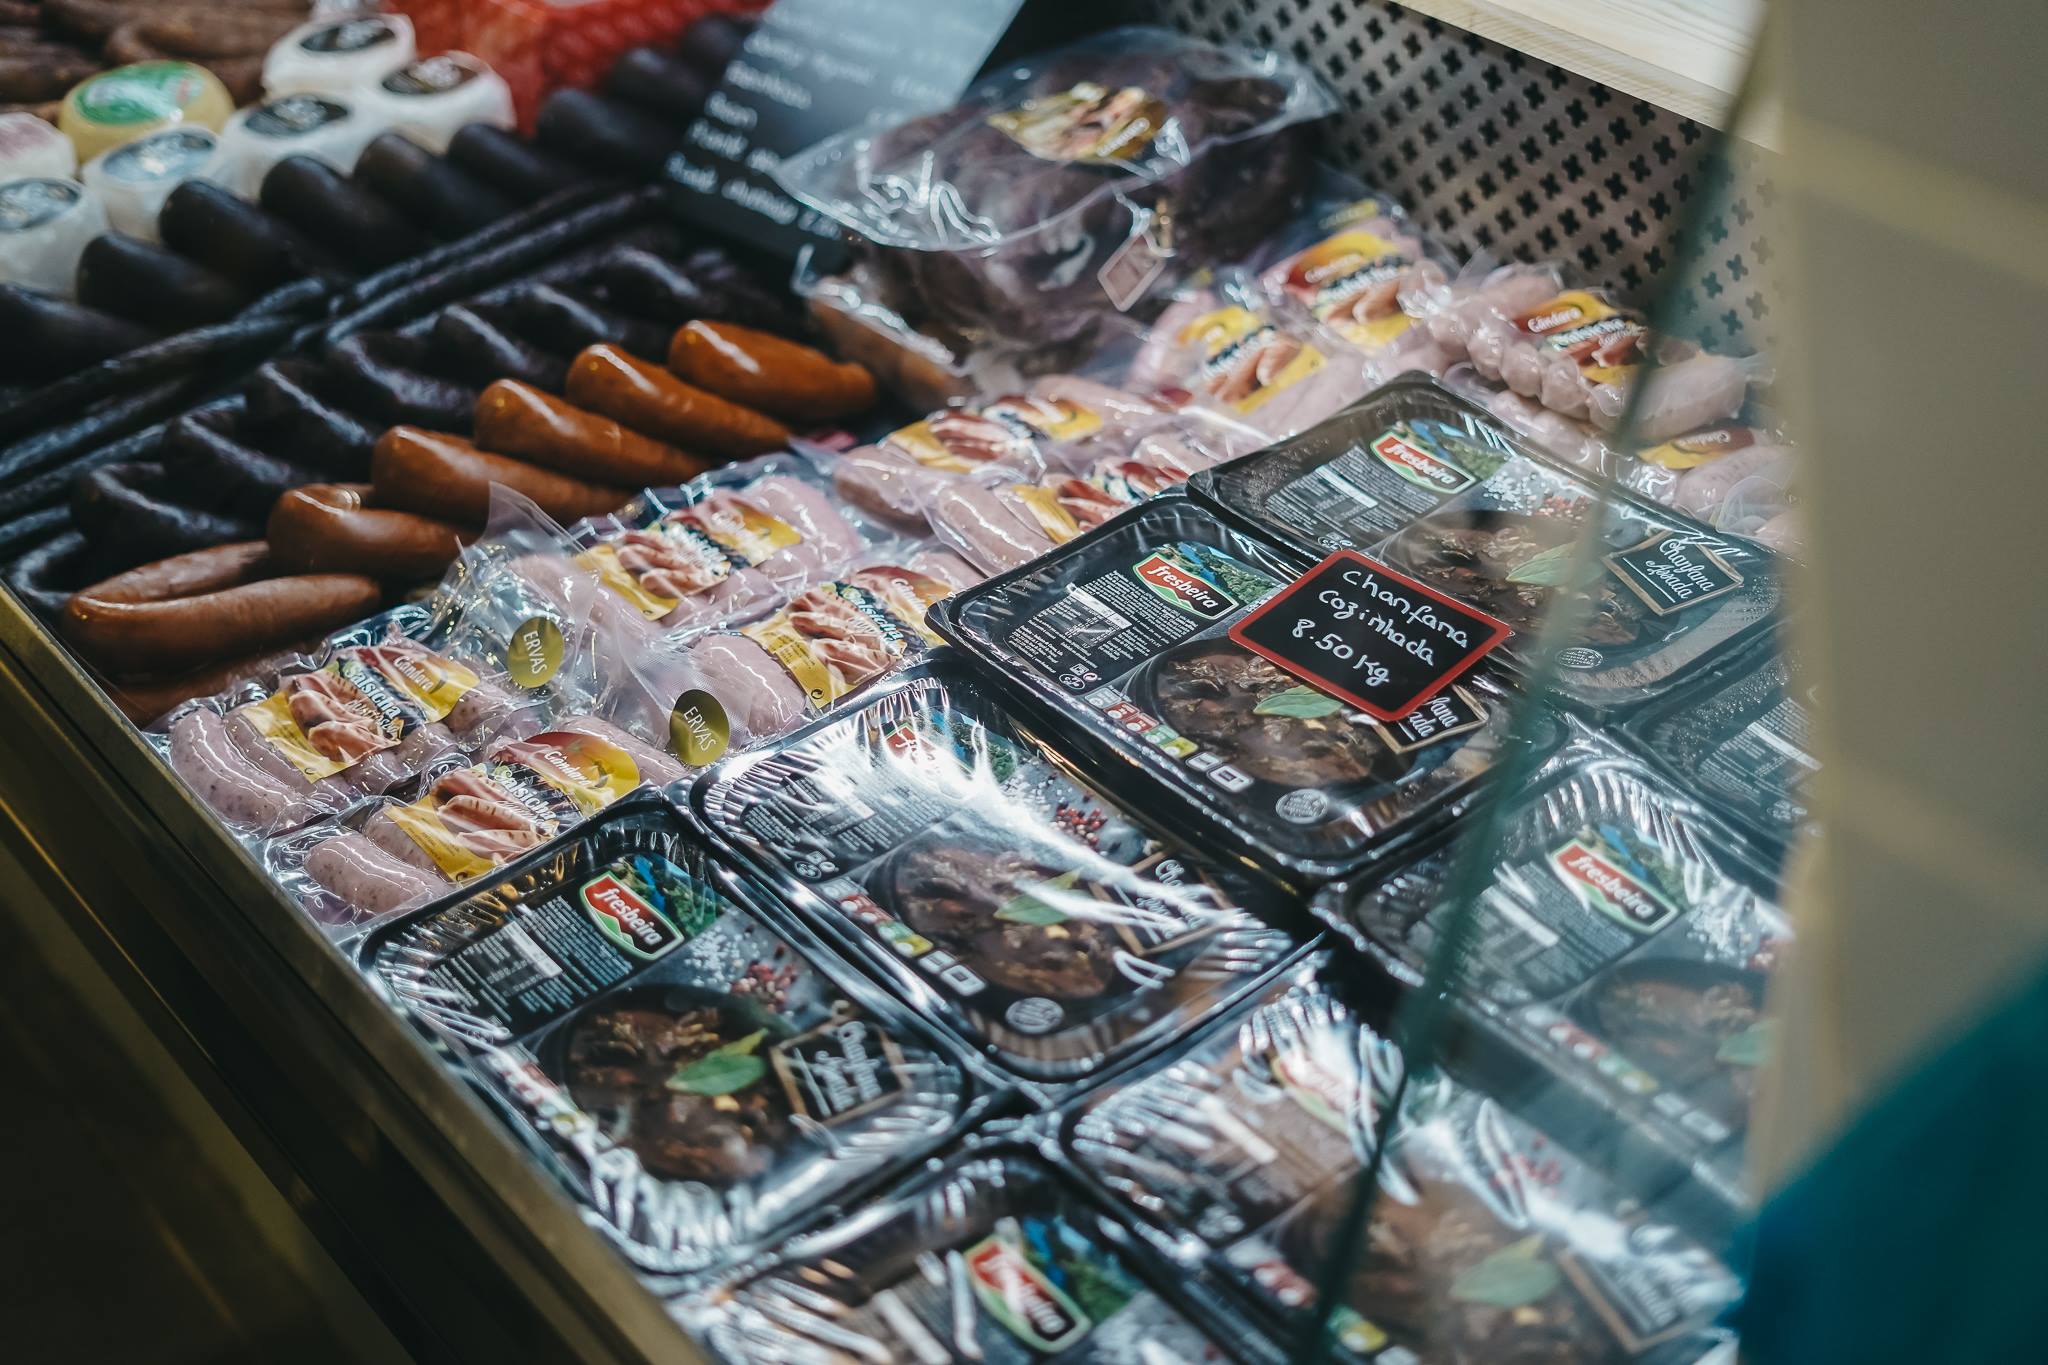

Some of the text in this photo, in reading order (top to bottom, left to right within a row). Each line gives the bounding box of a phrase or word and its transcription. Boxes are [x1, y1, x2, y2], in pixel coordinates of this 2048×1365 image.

[1384, 442, 1458, 485] fresbeira
[1147, 564, 1219, 609] fresbeira
[1659, 538, 1715, 591] Chanfana
[1318, 590, 1435, 667] Cozinhada
[1342, 570, 1468, 649] Chanfana
[523, 630, 547, 675] ERVAS
[1291, 618, 1355, 660] 8.50
[344, 661, 402, 718] Salsicha
[1423, 694, 1460, 729] fana
[683, 706, 717, 752] ERVAS
[493, 764, 556, 821] Salsicha
[1567, 854, 1656, 920] fresbeira
[593, 888, 663, 946] fresbeira
